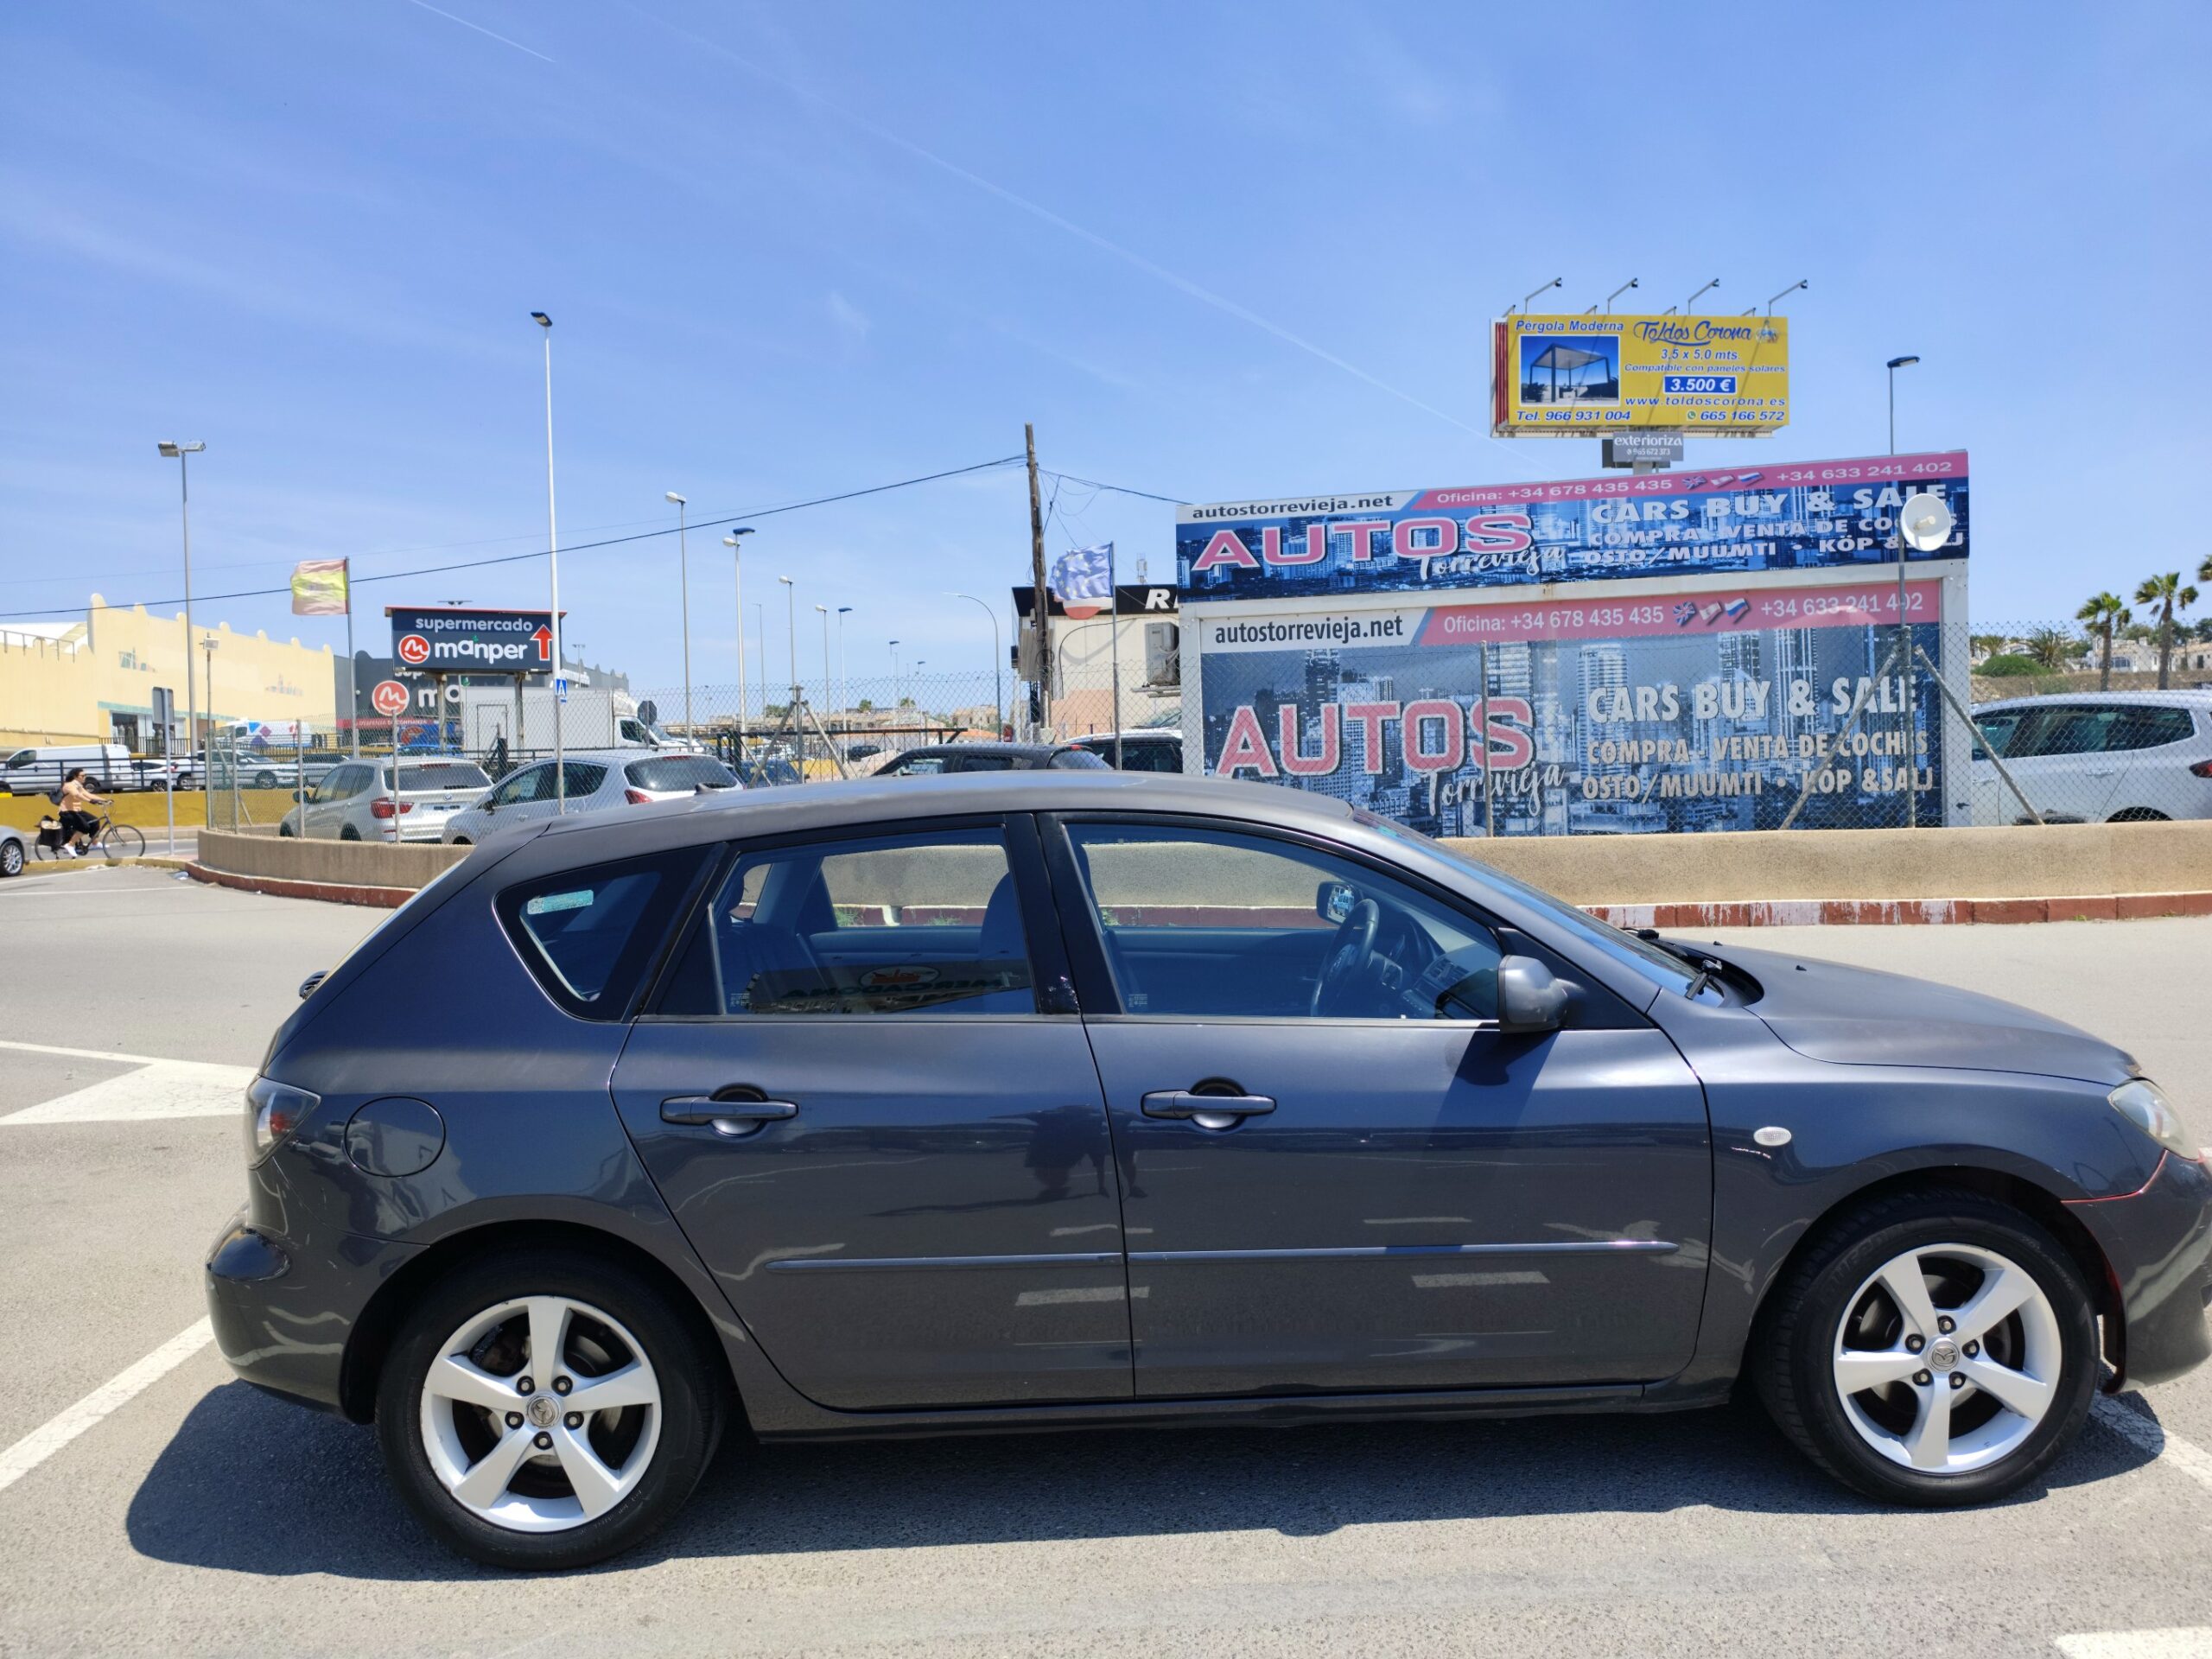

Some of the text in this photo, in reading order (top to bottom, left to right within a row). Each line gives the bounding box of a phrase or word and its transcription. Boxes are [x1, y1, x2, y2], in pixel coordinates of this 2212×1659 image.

[1516, 320, 1624, 333] Pérgola Moderna
[1633, 321, 1751, 343] Toldos Corona
[1661, 349, 1679, 360] 3,5
[1694, 349, 1712, 360] 5,0
[1624, 364, 1682, 373] Compatible
[1707, 365, 1745, 373] paneles
[1670, 378, 1732, 391] 3.500 €
[1625, 397, 1786, 406] www.toldoscorona.es
[1516, 411, 1630, 421] Tel. 966 931 004
[1700, 411, 1785, 421] 665 166 572
[1614, 434, 1683, 447] exterioriza
[1777, 461, 1953, 482] +34 633 241 402
[1437, 480, 1673, 504] Oficina: +34 678 435 435
[1192, 495, 1394, 518] autostorrevieja.net
[1592, 499, 1690, 524] CARS
[1706, 493, 1789, 518] BUY
[1806, 491, 1837, 512] &
[1191, 514, 1534, 571] AUTOS
[1589, 527, 1700, 546] COMPRA
[1726, 520, 1808, 539] VENTA
[1816, 518, 1849, 534] DE
[1819, 534, 1874, 553] KÖP
[1417, 544, 1567, 582] Torrevieja
[1145, 588, 1179, 609] R
[1761, 599, 1797, 617] +34
[1802, 596, 1840, 615] 633
[1845, 594, 1881, 613] 241
[415, 617, 533, 633] supermercado
[1215, 613, 1403, 644] autostorrevieja.net
[1444, 606, 1664, 633] Oficina: +34 678 435 435
[435, 639, 528, 664] manper
[1587, 684, 1680, 723] CARS
[1694, 680, 1771, 720] BUY
[1787, 678, 1817, 717] &
[1214, 696, 1535, 778] AUTOS
[1587, 738, 1691, 765] COMPRA
[1713, 735, 1789, 761] VENTA
[1799, 734, 1828, 758] DE
[1838, 730, 1929, 757] COCHS
